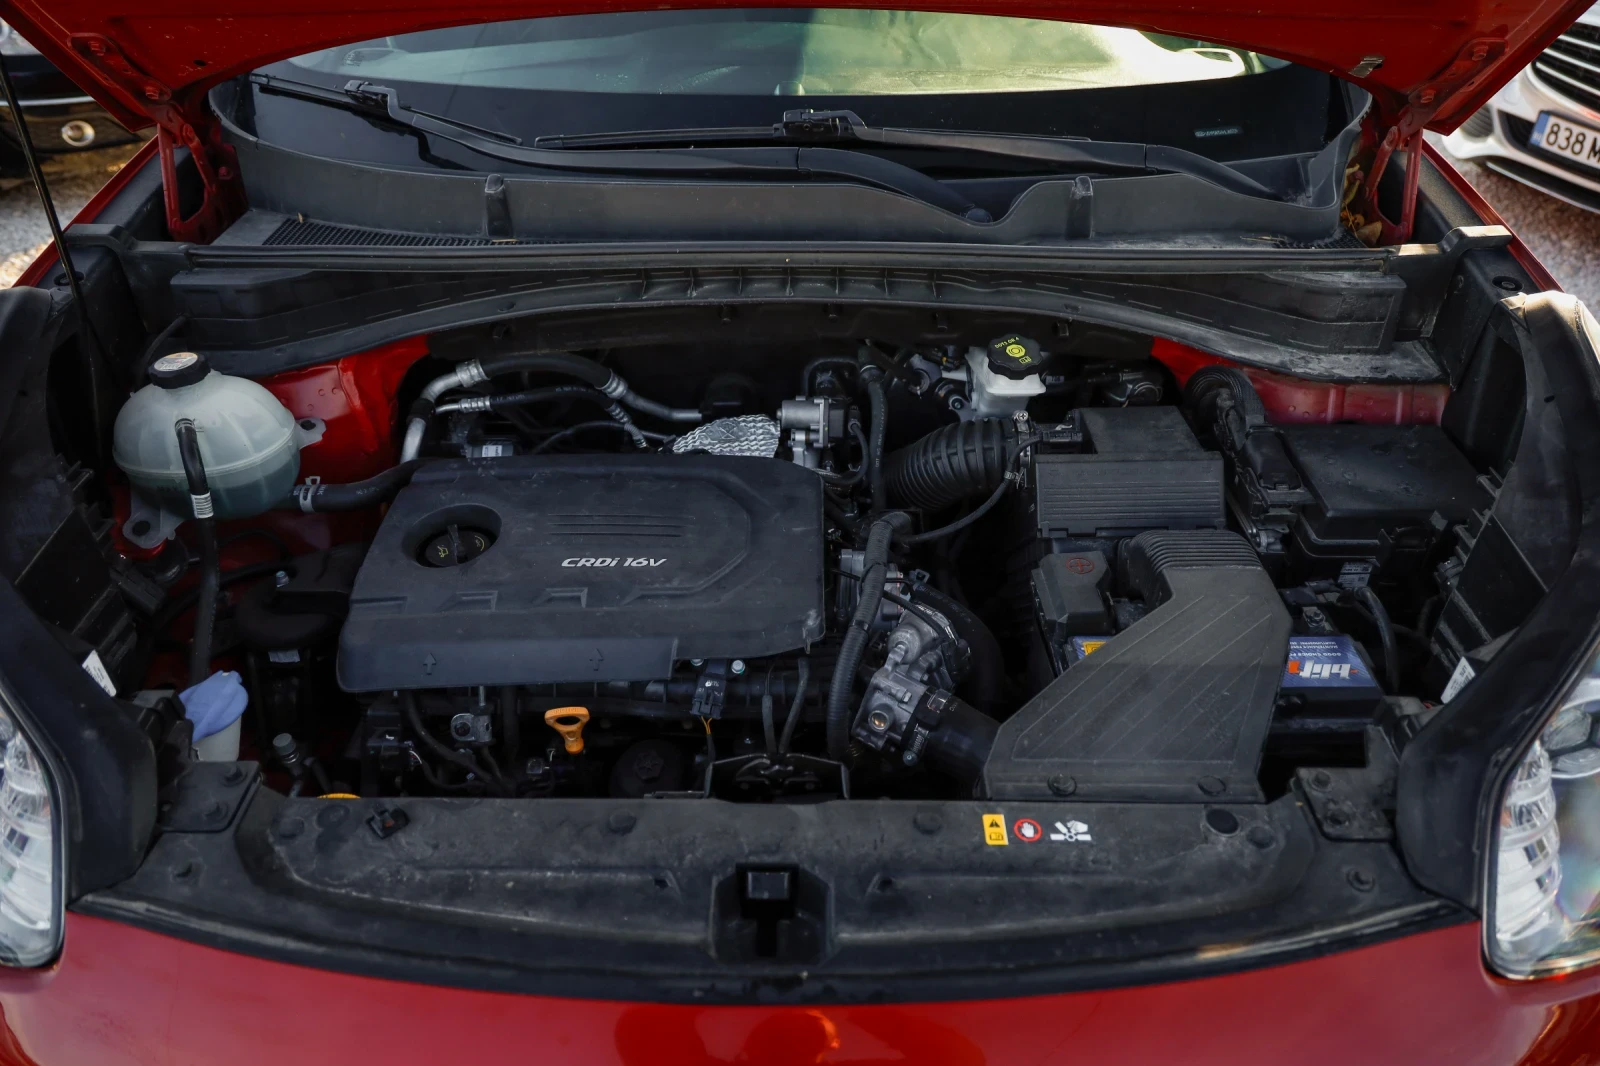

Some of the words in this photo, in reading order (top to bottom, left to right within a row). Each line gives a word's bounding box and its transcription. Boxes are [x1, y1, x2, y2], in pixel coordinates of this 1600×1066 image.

[1545, 123, 1587, 155] 838
[561, 557, 621, 567] CRDi
[623, 557, 668, 567] 16V
